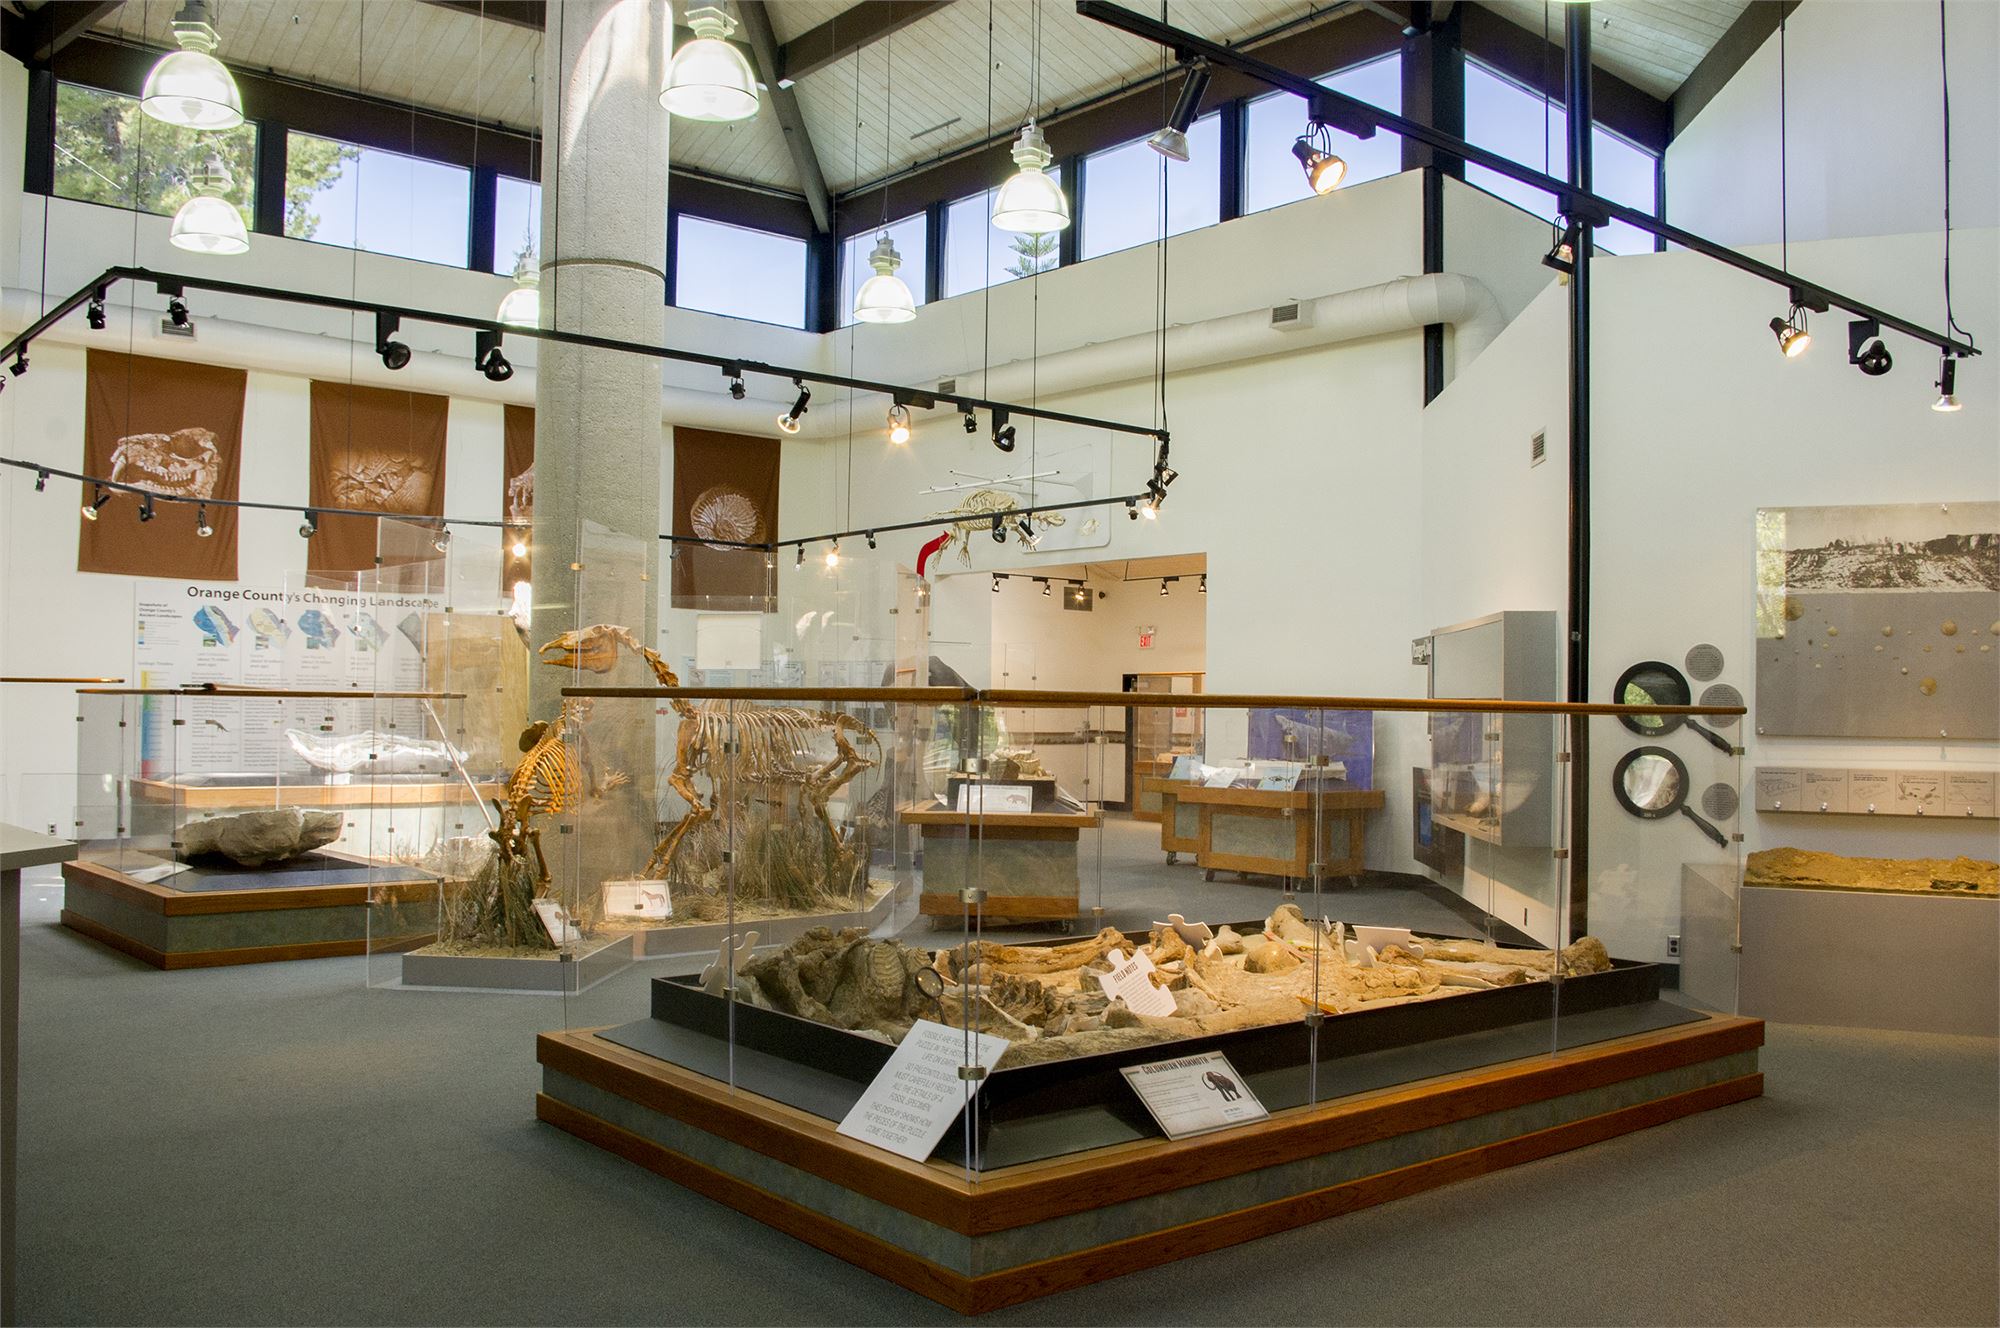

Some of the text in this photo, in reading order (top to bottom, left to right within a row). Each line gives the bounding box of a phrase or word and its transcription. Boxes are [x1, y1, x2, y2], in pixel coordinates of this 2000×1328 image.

[187, 586, 239, 601] Orange
[242, 589, 300, 605] County's
[303, 592, 366, 607] Changing
[1113, 961, 1138, 984] FIELD NOTES
[1142, 1057, 1209, 1074] COLUMBIAN MAMMOTH
